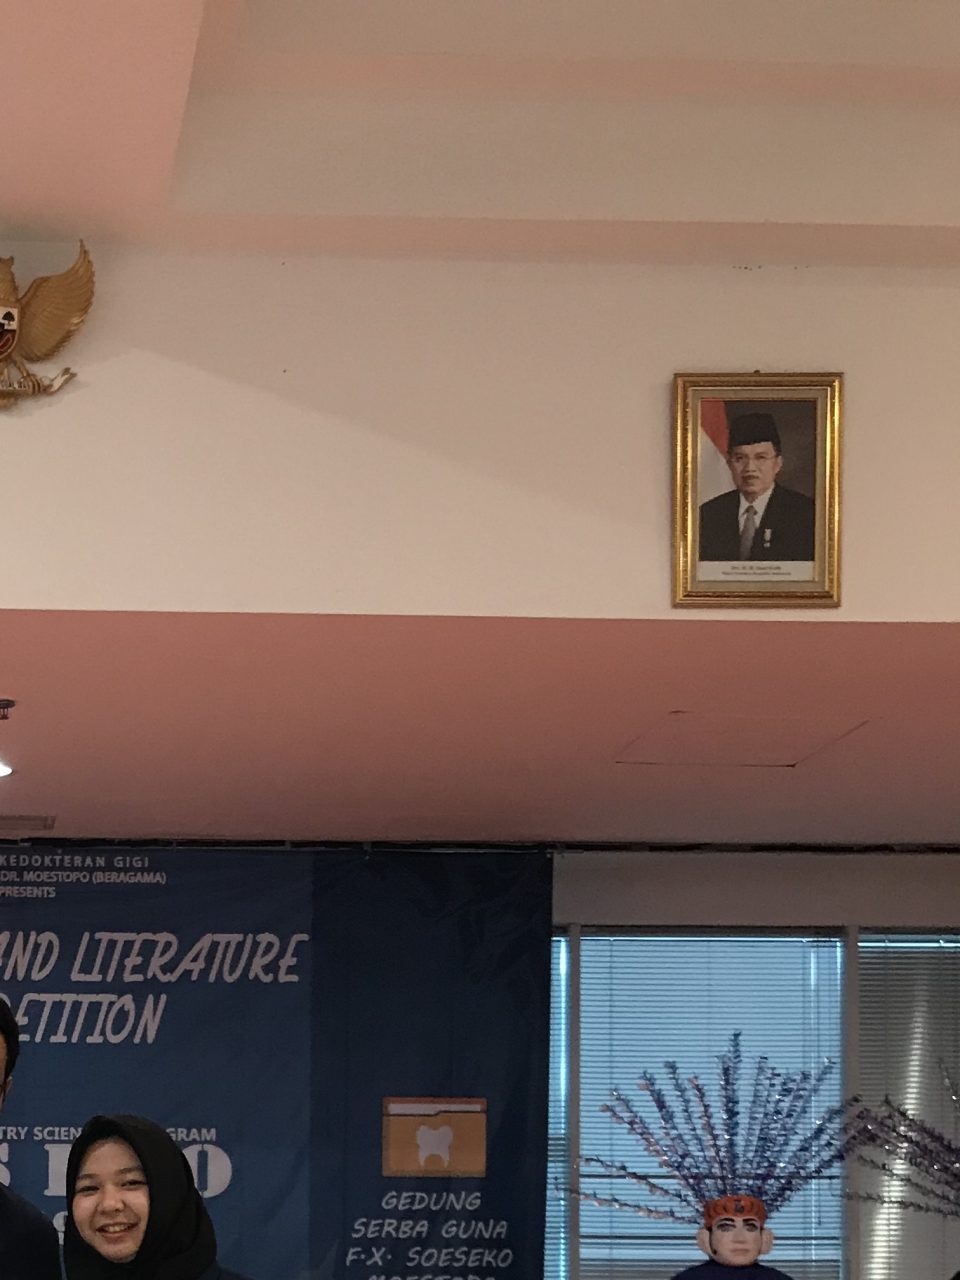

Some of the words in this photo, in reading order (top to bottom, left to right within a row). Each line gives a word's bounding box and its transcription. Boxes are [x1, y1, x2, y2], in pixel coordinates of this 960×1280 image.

[0, 855, 105, 867] KEDOKTERAN
[114, 857, 149, 868] GIGI
[0, 871, 20, 881] DR.
[23, 871, 89, 883] MOESTOPO
[92, 872, 167, 885] (BERAGAMA)
[70, 931, 310, 983] LITERATURE
[381, 1191, 481, 1210] GEDUNG
[351, 1218, 428, 1238] SERBA
[441, 1219, 508, 1239] GUNA
[406, 1247, 513, 1267] SOESEKO
